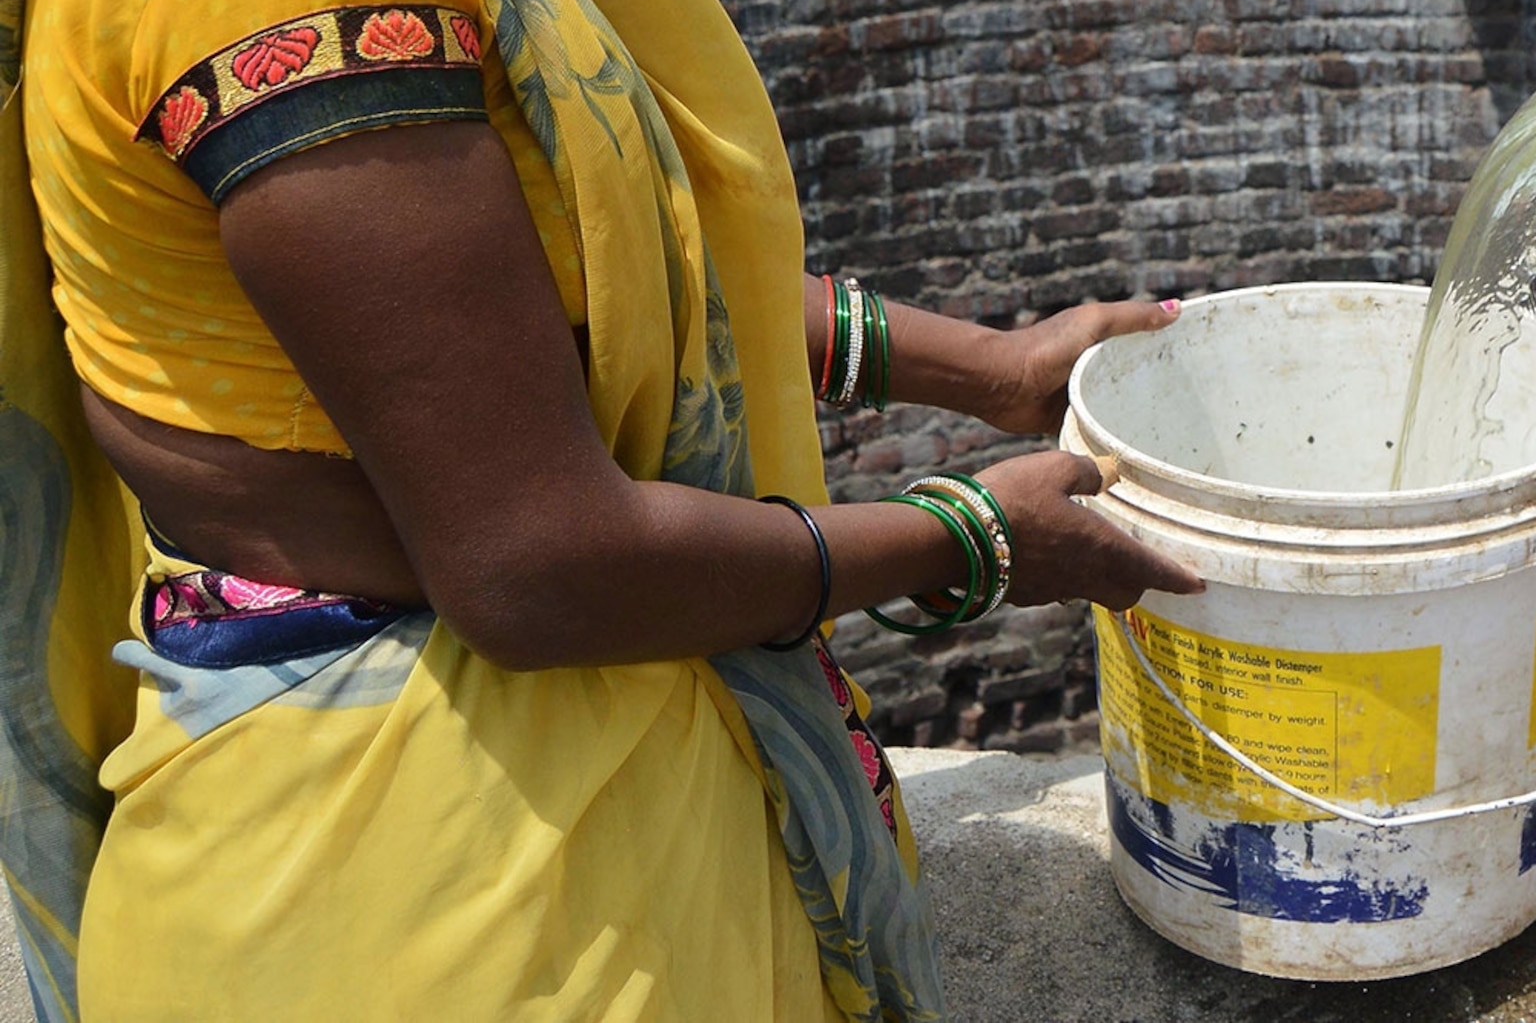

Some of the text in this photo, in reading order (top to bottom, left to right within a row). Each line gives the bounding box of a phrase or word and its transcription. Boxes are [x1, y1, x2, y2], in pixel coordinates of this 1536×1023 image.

[1173, 632, 1196, 652] Finish
[1228, 650, 1271, 669] Washable
[1275, 658, 1323, 675] Distemper
[1252, 672, 1271, 683] wall
[1190, 676, 1214, 691] FOR
[1219, 684, 1249, 700] USE:
[1212, 701, 1263, 719] distemper
[1268, 712, 1282, 724] by
[1243, 738, 1263, 749] and
[1266, 743, 1293, 754] wipe
[1274, 755, 1329, 769] Washable
[1318, 785, 1329, 795] of
